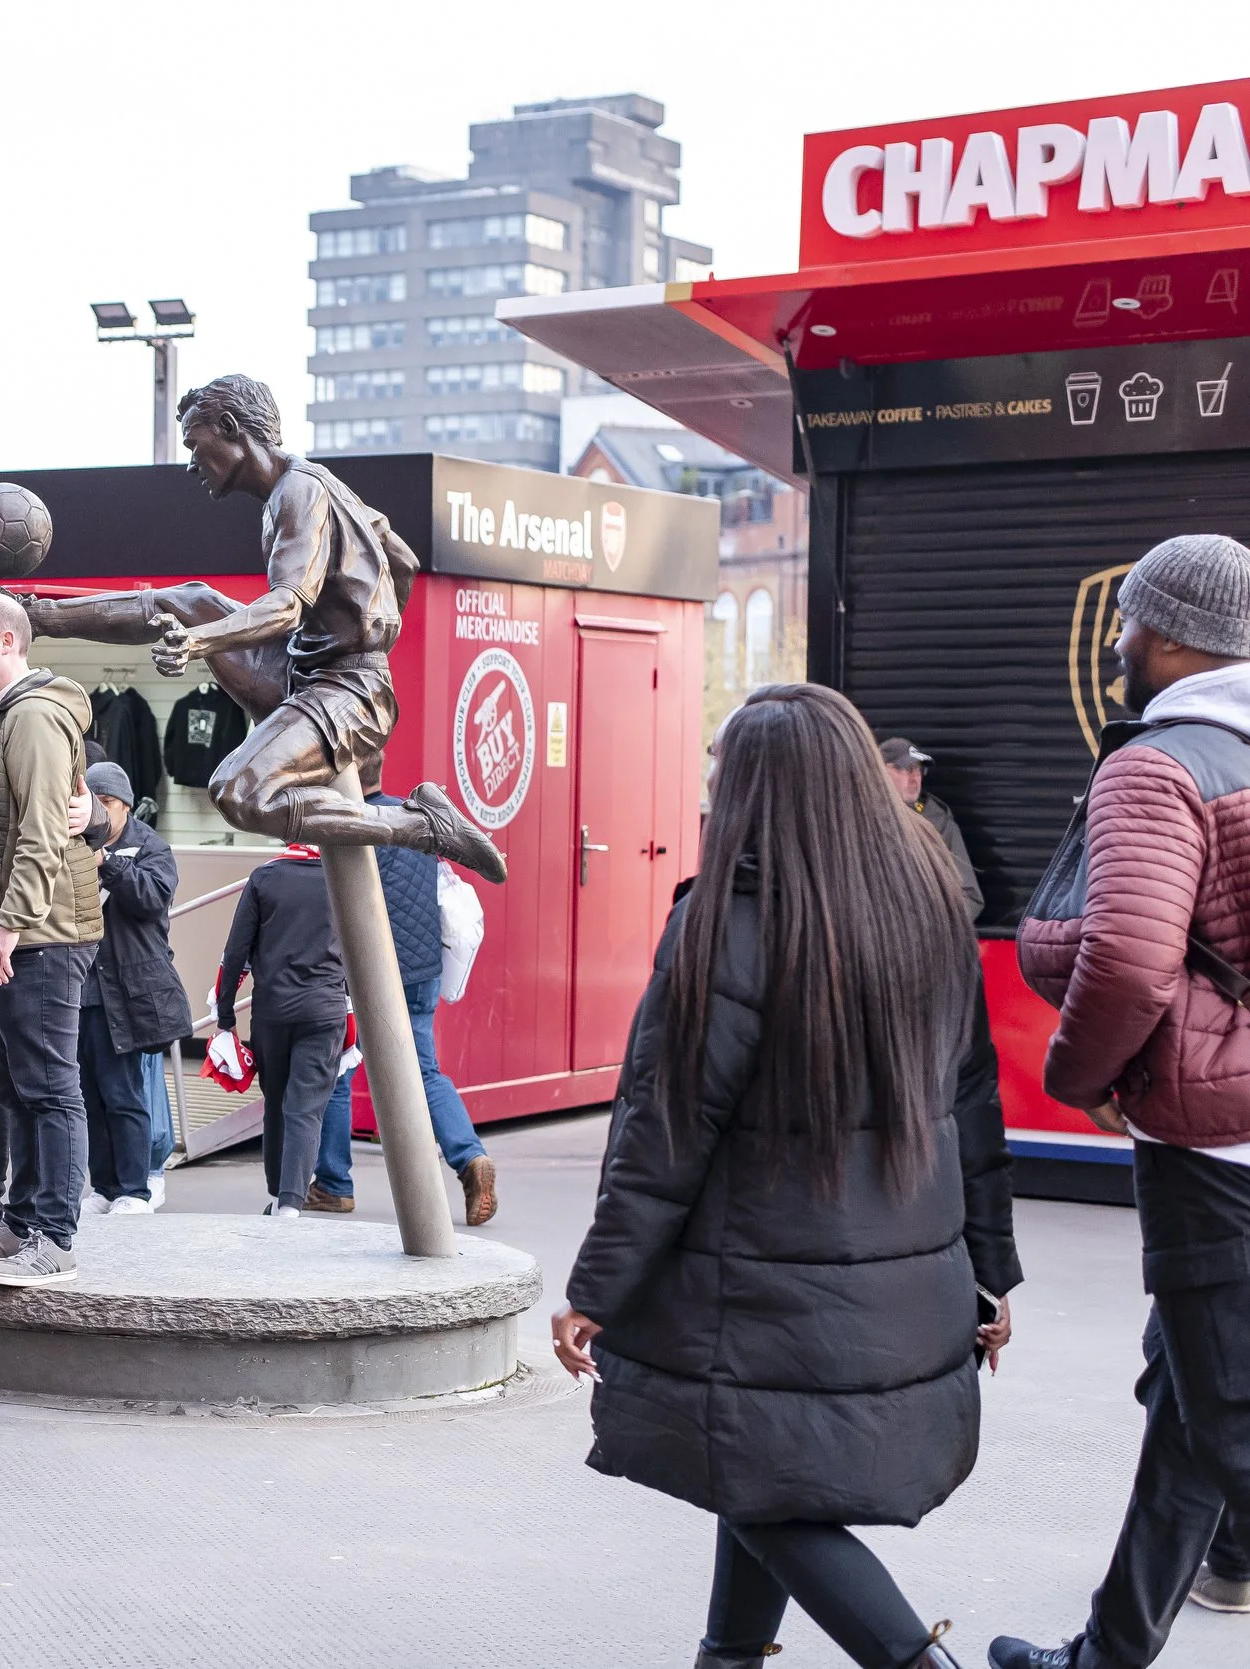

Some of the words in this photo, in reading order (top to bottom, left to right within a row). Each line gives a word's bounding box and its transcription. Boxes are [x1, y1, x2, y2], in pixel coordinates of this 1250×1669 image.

[822, 101, 1250, 239] CHAPMA
[807, 409, 875, 428] TAKEAWAY
[877, 406, 923, 424] COFFEE
[935, 402, 992, 419] PASTRIES
[994, 402, 1007, 416] &
[1007, 398, 1052, 416] CAKES
[447, 490, 495, 546] The
[499, 499, 593, 560] Arsenal
[542, 559, 595, 583] MATCHDAY
[455, 588, 507, 616] OFFICIAL
[455, 615, 540, 645] MERCHANDISE
[476, 709, 516, 781] BUY
[484, 741, 521, 800] DIRECT
